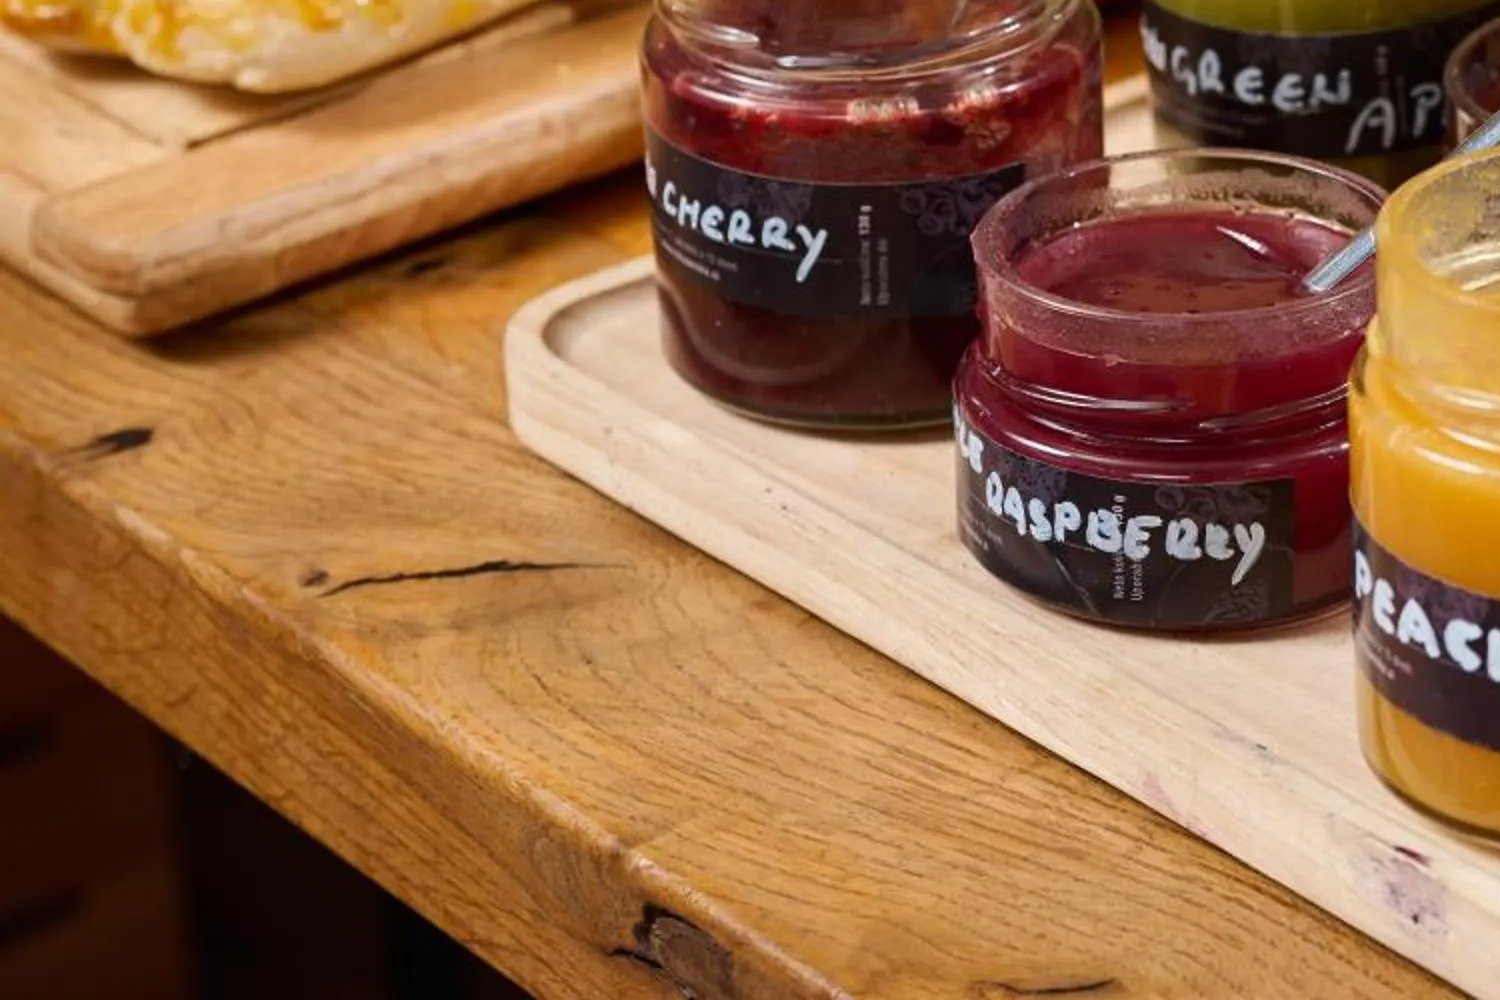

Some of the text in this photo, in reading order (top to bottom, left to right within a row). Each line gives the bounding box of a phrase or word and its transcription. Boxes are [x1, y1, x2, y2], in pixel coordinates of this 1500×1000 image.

[1171, 45, 1351, 113] GREEN
[1344, 82, 1446, 154] AP
[663, 181, 828, 284] CHERRY
[986, 471, 1266, 587] RASPBERRY
